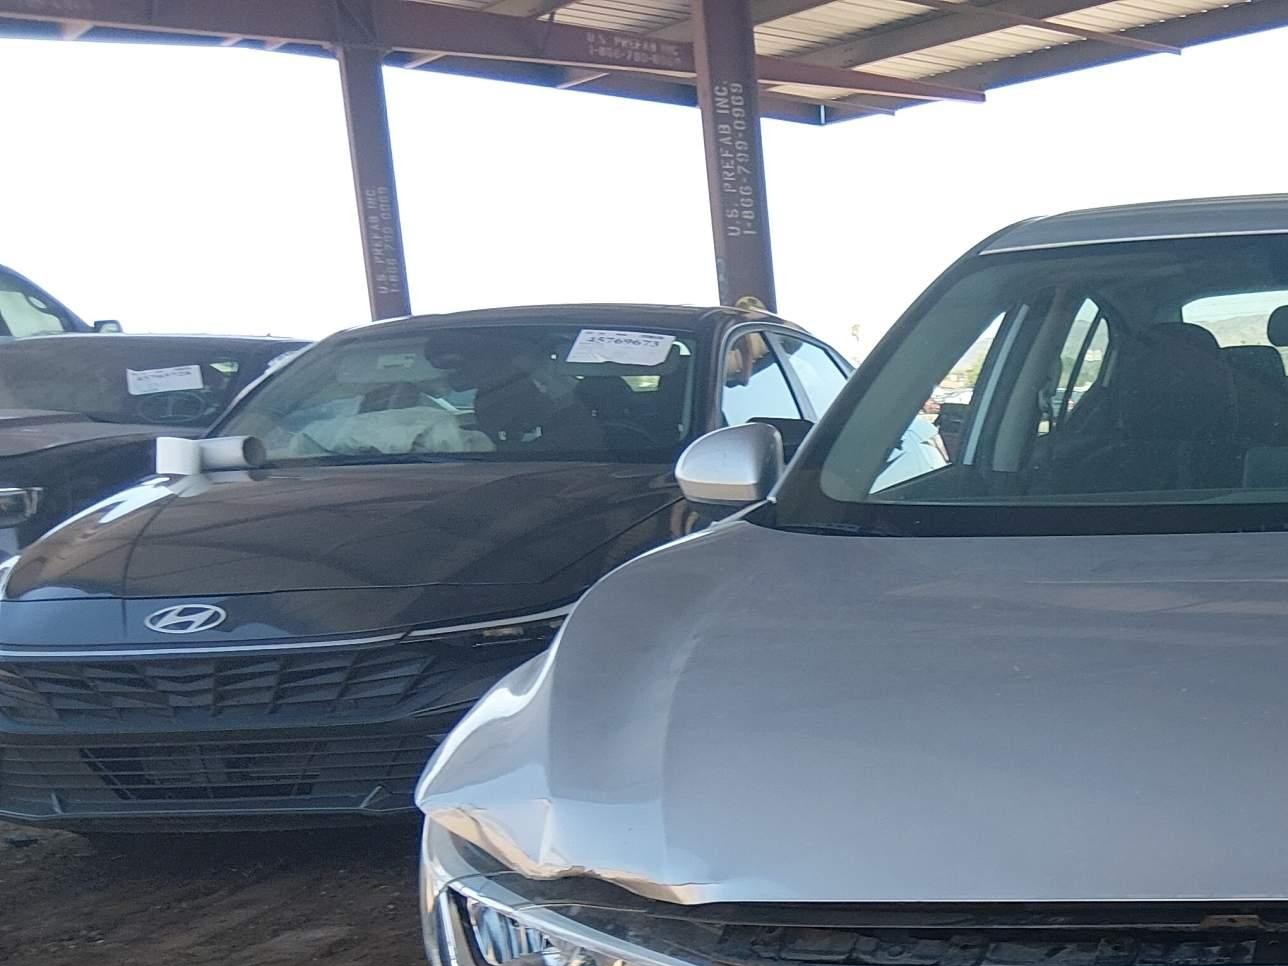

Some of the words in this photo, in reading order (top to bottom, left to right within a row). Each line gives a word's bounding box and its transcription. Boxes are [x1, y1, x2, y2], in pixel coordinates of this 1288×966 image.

[713, 80, 729, 115] INC.
[718, 124, 737, 193] PREFAB
[725, 203, 741, 237] U.S.
